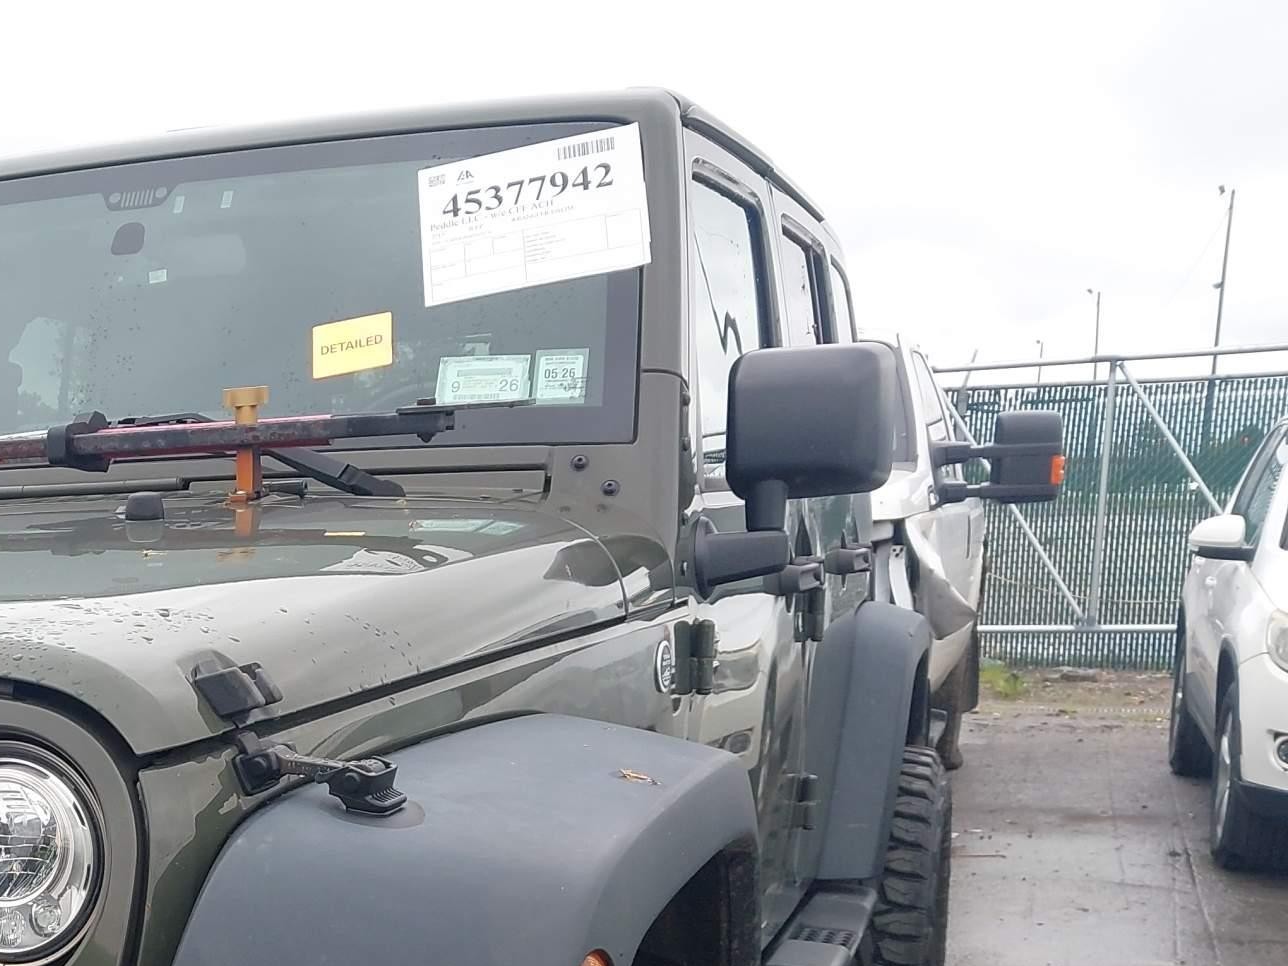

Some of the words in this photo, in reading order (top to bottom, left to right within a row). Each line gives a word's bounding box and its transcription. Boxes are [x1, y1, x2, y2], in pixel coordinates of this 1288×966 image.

[442, 162, 614, 218] 45377942
[320, 333, 384, 356] DETAILED
[544, 368, 558, 379] 05
[562, 367, 576, 379] 26
[451, 380, 461, 393] 9
[499, 379, 519, 392] 26
